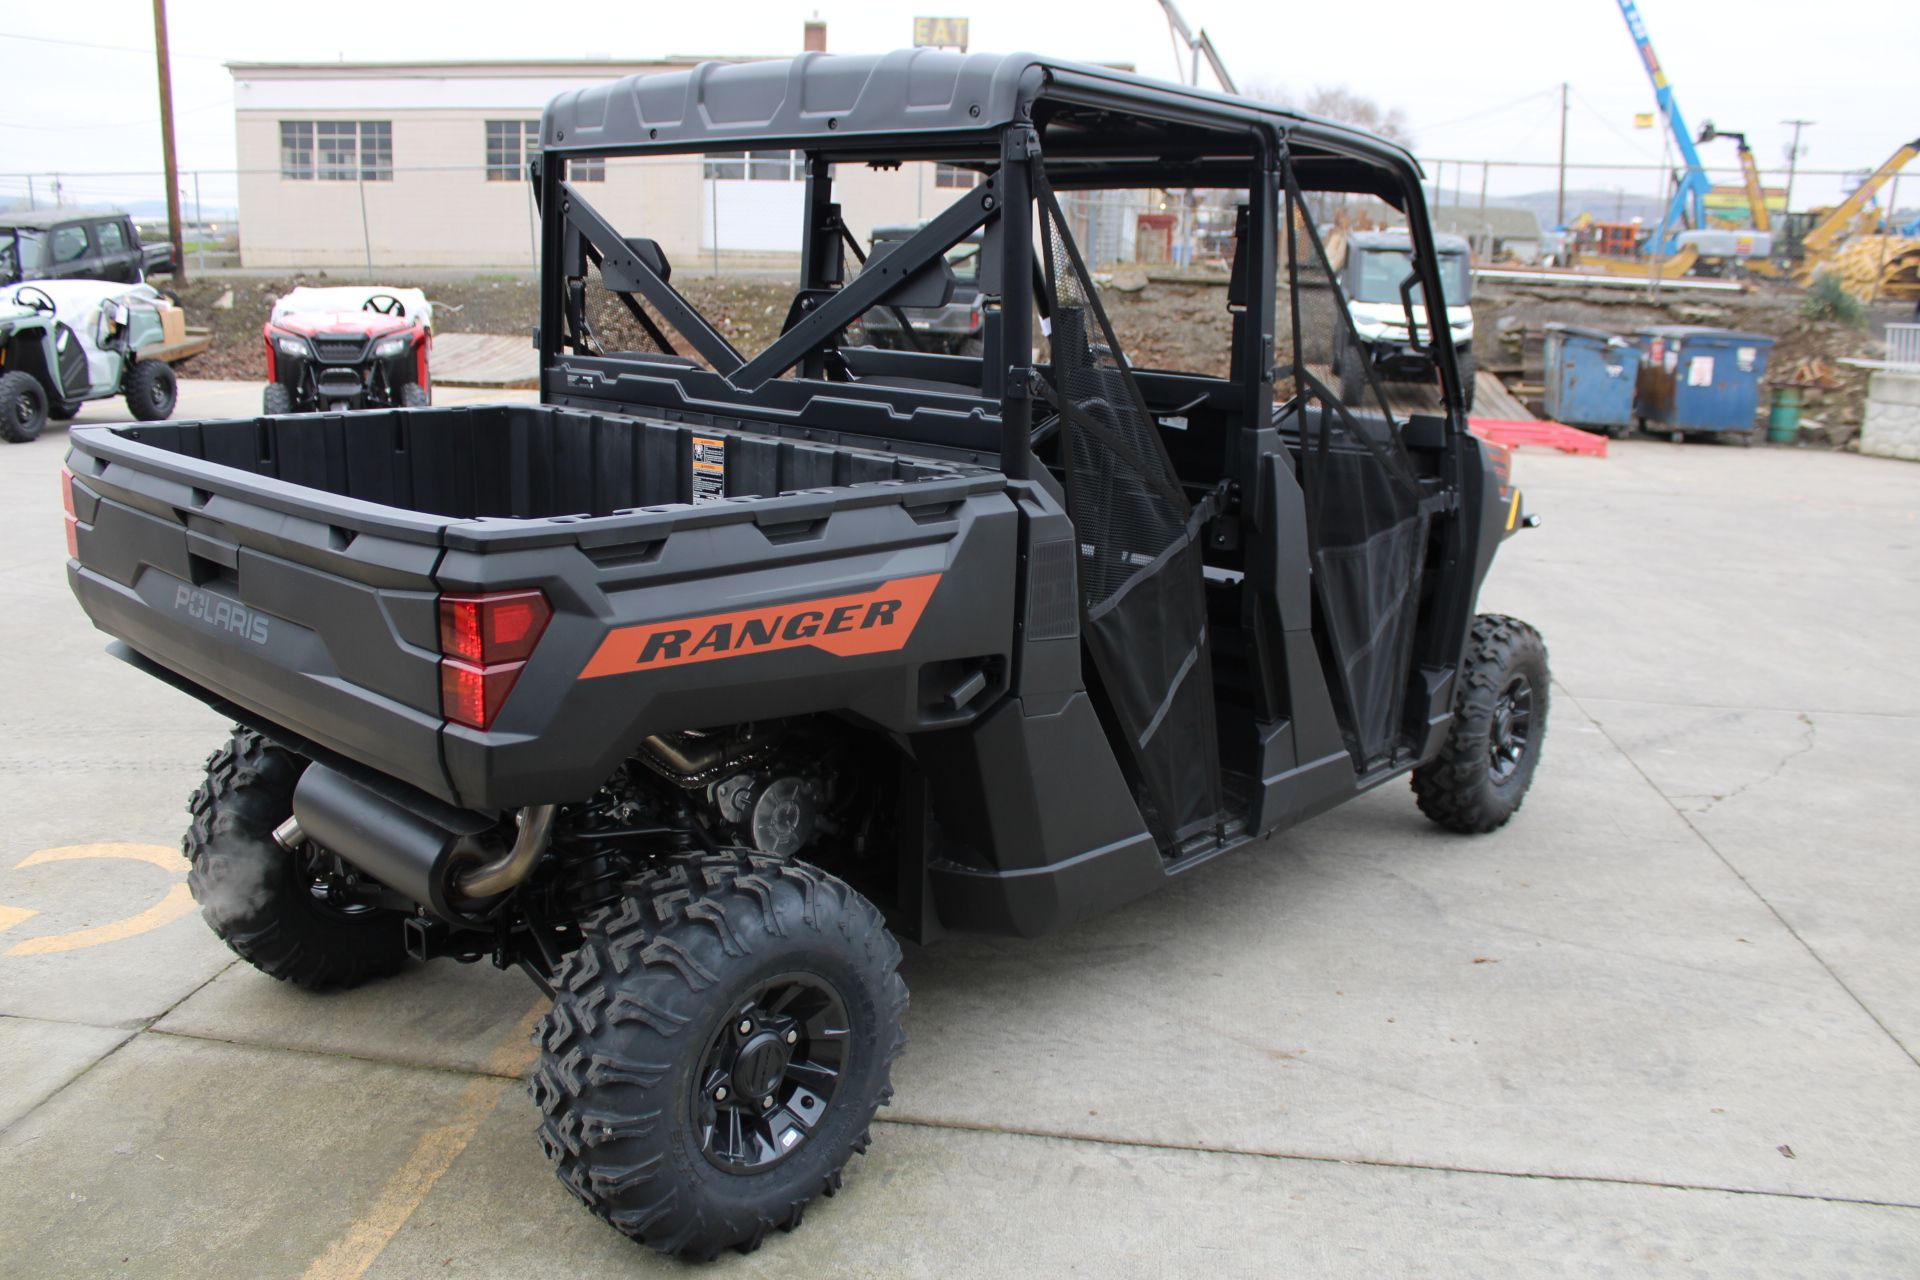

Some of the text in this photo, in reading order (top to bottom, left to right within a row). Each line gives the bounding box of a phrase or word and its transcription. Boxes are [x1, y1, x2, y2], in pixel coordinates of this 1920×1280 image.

[914, 18, 968, 44] EAT
[175, 585, 269, 645] POLARIS
[636, 599, 902, 663] RANGER
